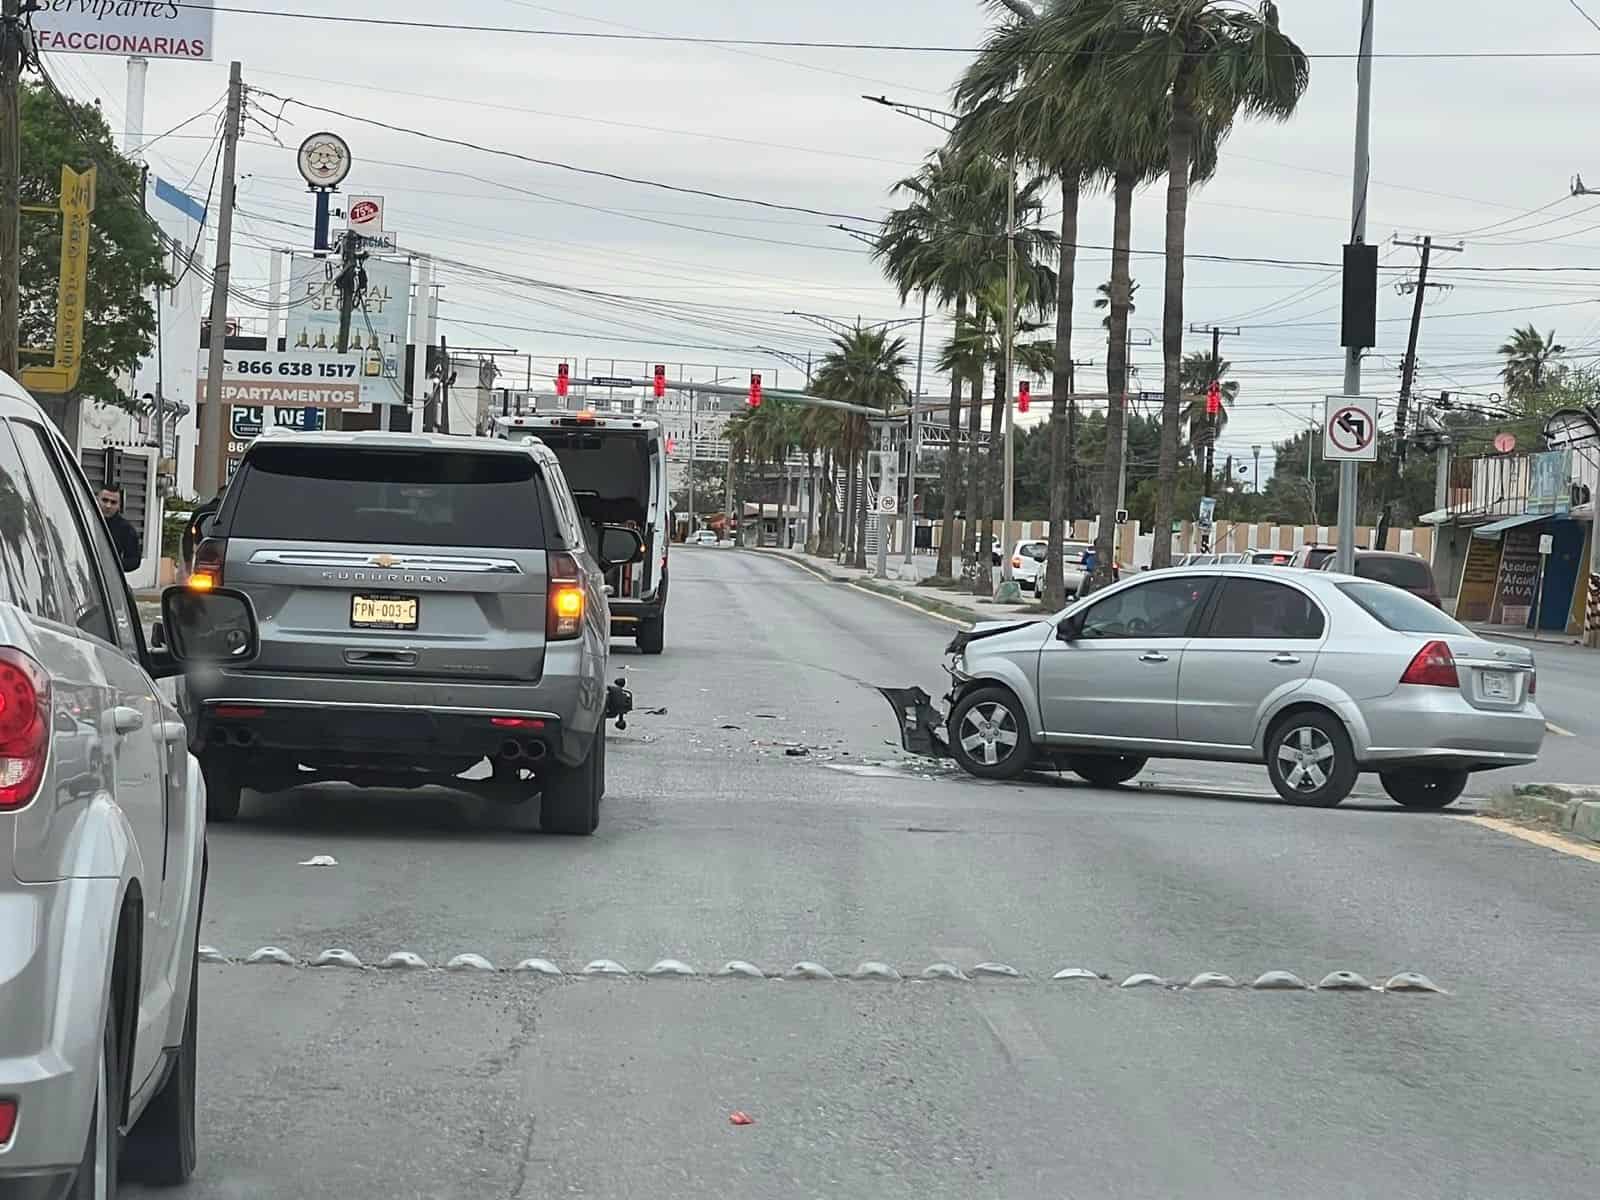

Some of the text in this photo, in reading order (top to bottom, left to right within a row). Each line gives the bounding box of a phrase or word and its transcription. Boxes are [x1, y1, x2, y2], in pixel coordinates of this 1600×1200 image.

[34, 30, 205, 57] FACCIONARIAS
[306, 281, 393, 300] ETEAL
[311, 296, 387, 313] SECET
[237, 360, 356, 378] 866 638 1517
[202, 384, 355, 404] PARTAMENTOS
[232, 406, 324, 426] PLNE
